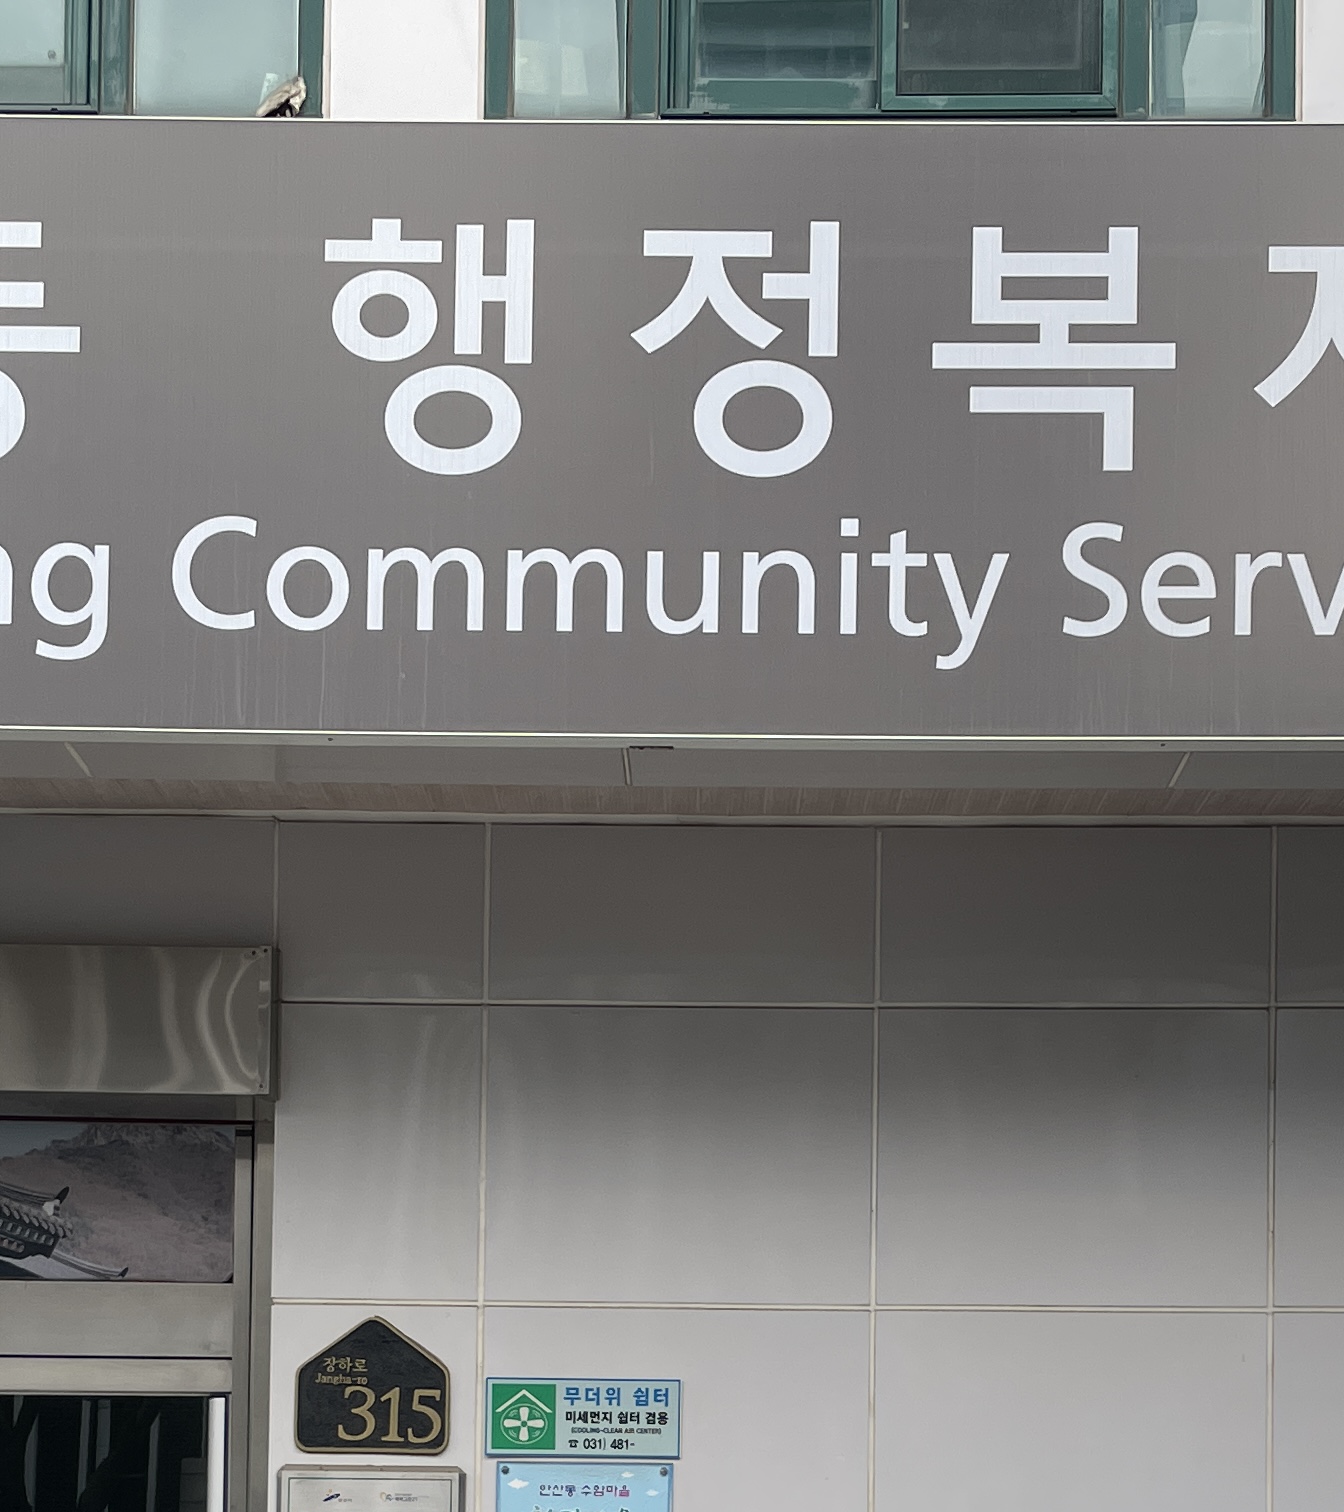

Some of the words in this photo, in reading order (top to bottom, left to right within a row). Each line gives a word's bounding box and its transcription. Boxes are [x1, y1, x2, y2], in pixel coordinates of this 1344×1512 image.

[170, 514, 1010, 670] Community
[322, 1356, 368, 1373] 장하로
[315, 1373, 368, 1385] Jangha-ro
[563, 1386, 622, 1407] 무더위
[632, 1387, 670, 1408] 쉼터
[337, 1386, 443, 1444] 315
[565, 1411, 613, 1425] 미세먼지
[617, 1411, 640, 1425] 쉼터
[645, 1412, 669, 1425] 겸용
[539, 1484, 576, 1497] 안산동
